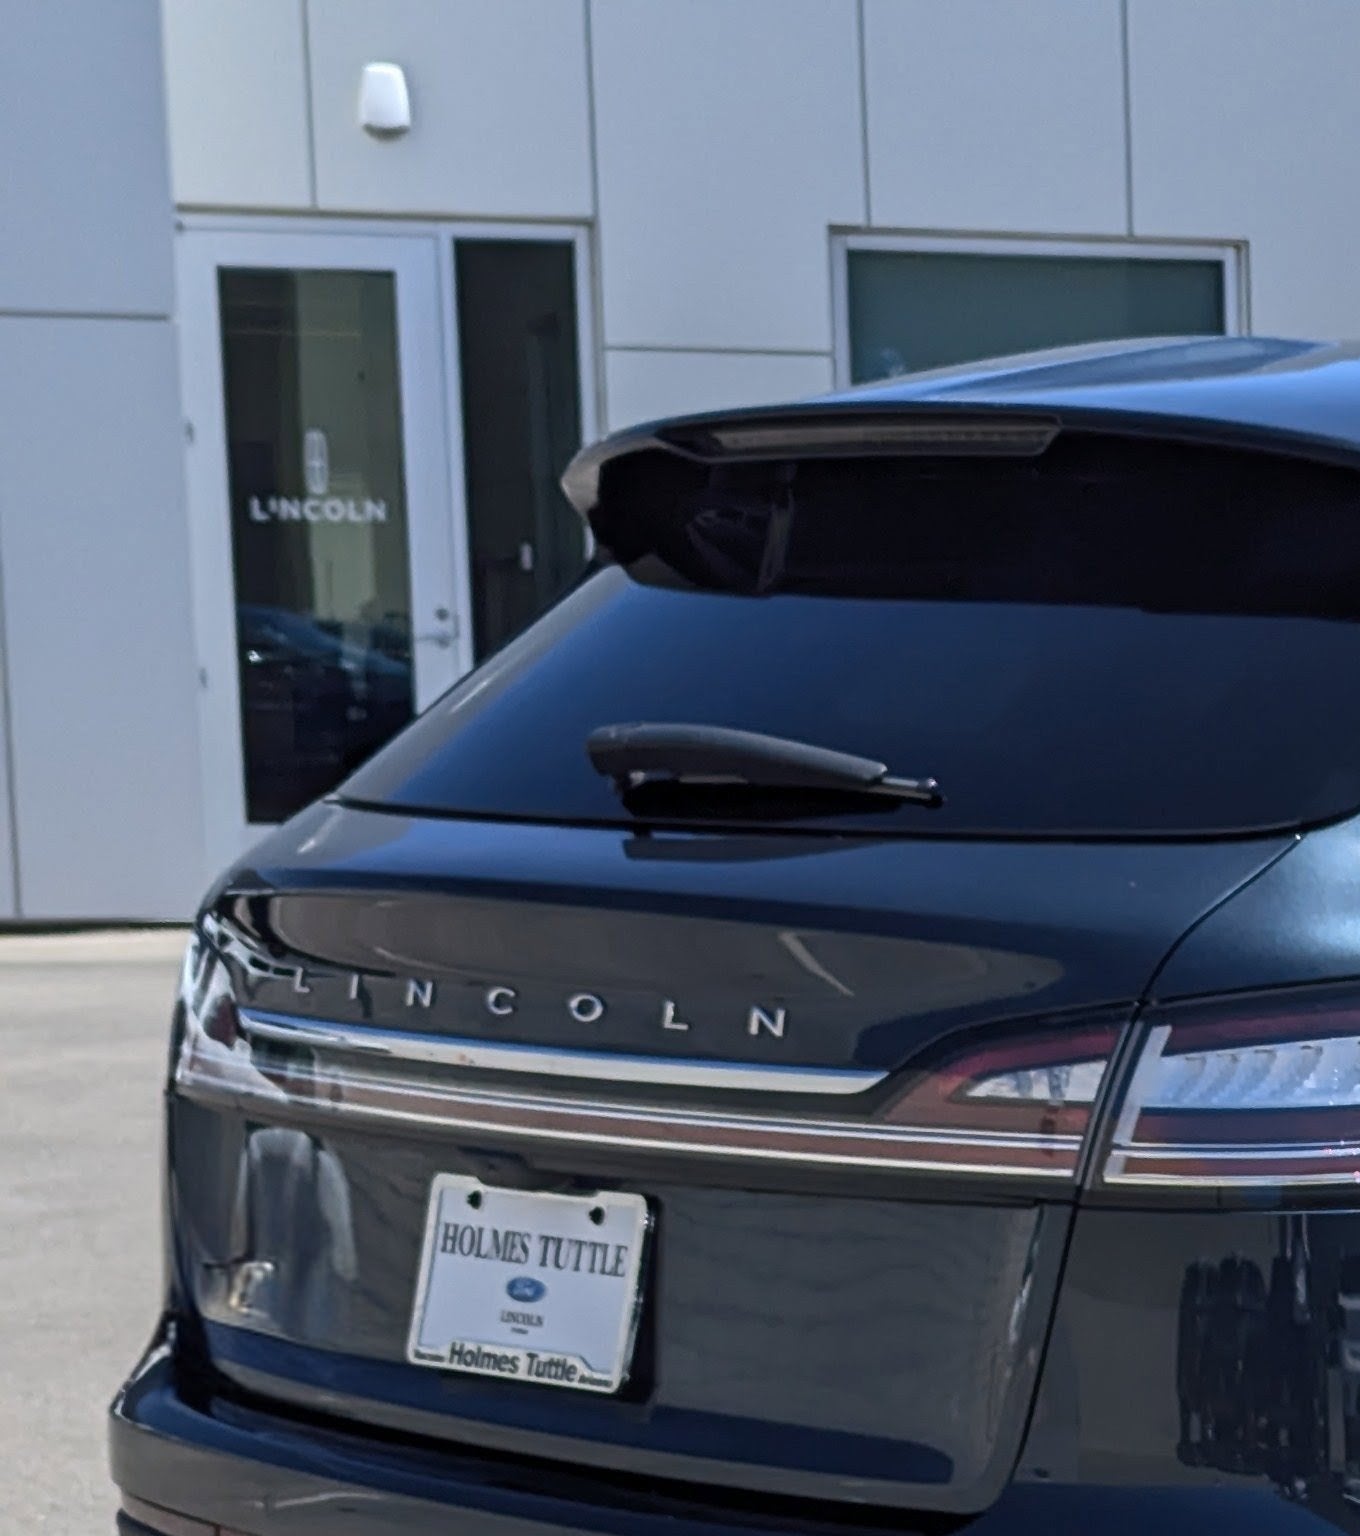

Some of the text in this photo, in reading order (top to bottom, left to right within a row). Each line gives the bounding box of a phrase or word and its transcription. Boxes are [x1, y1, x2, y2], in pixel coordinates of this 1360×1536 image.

[250, 496, 387, 522] LINCOLN
[293, 966, 787, 1038] LINCOLN
[440, 1222, 628, 1278] HOLMES TUTTLE
[448, 1341, 520, 1375] Holmes
[526, 1352, 578, 1383] Tuttle
